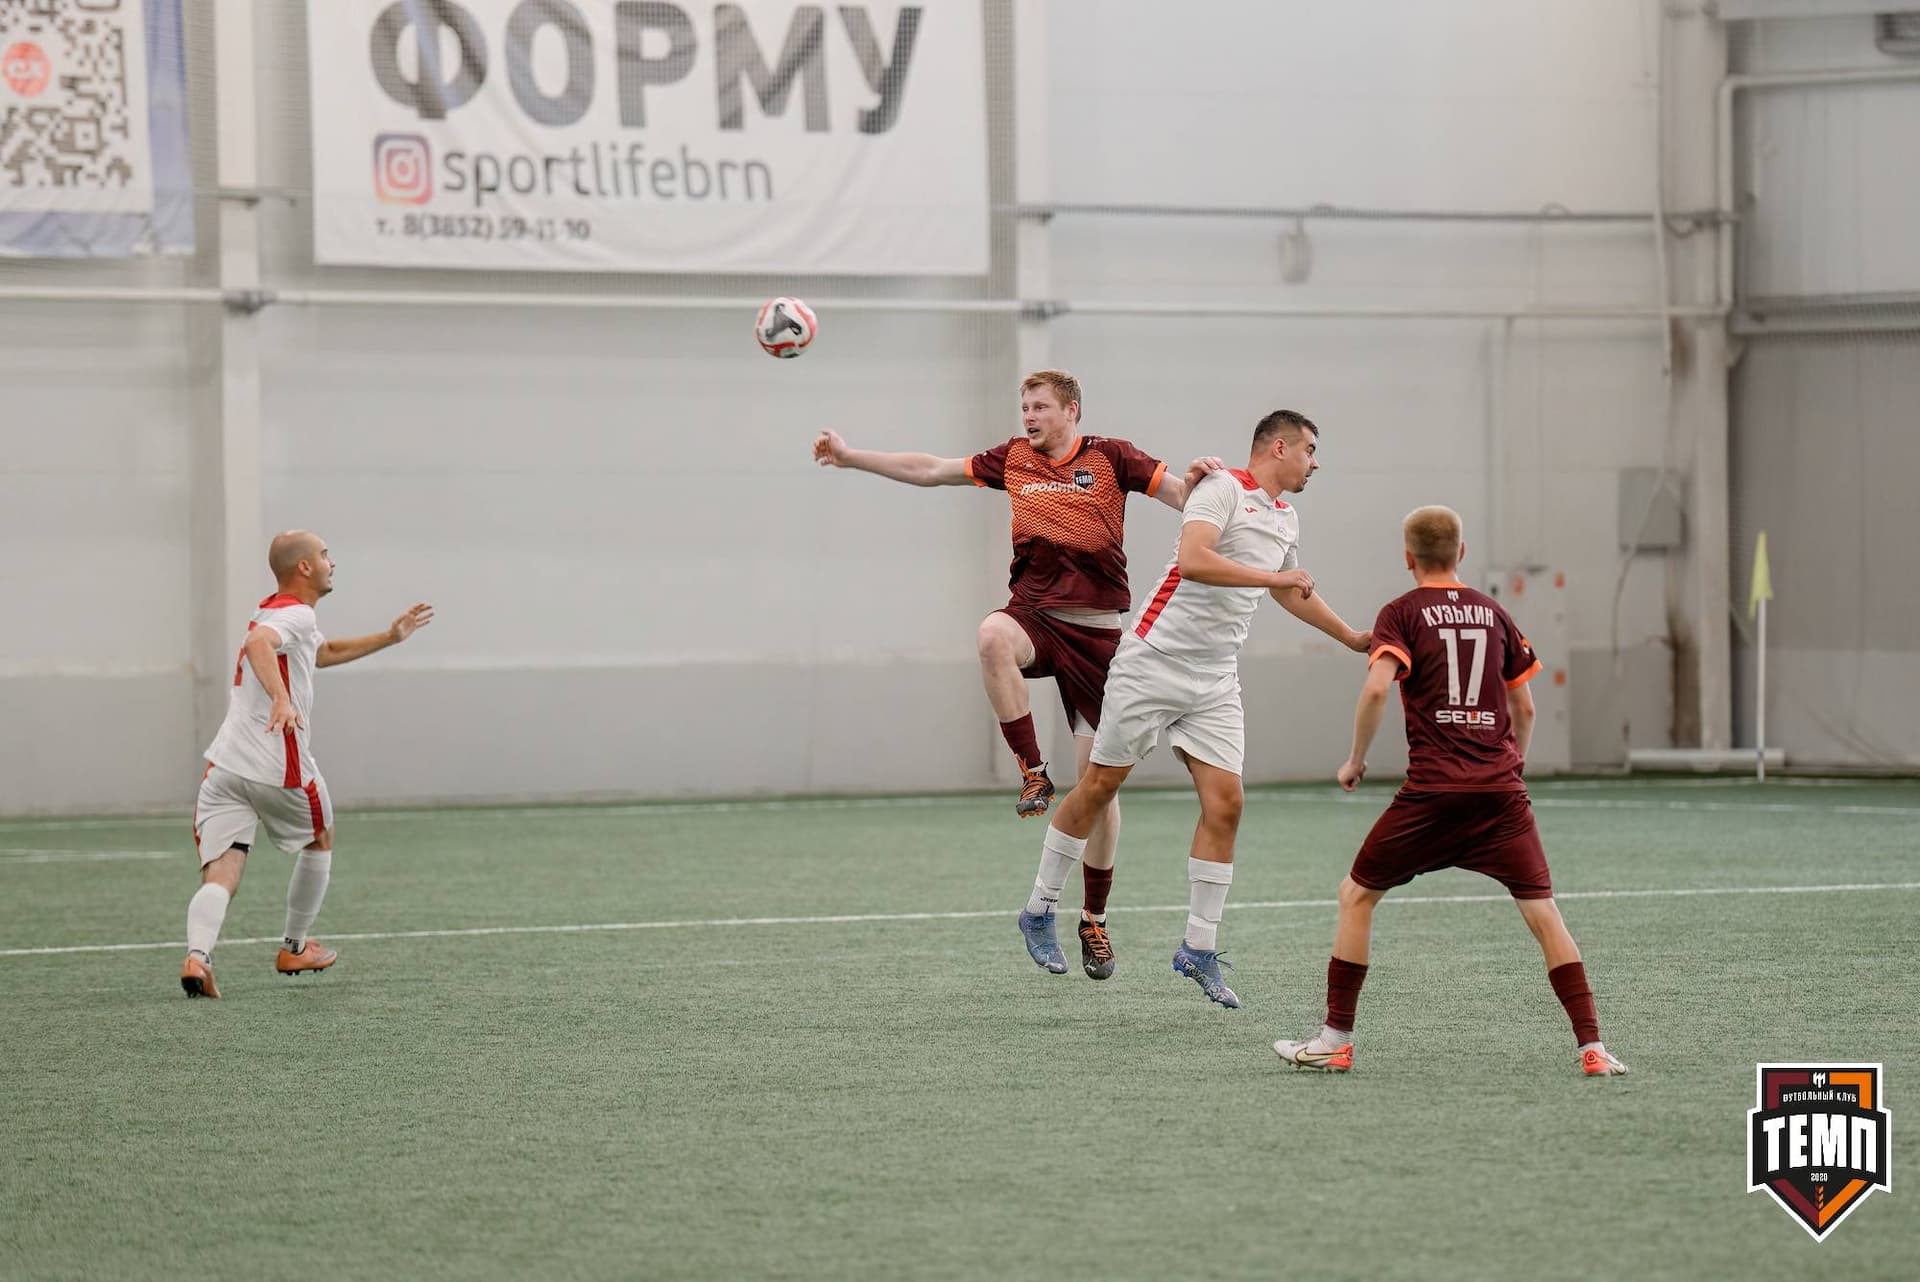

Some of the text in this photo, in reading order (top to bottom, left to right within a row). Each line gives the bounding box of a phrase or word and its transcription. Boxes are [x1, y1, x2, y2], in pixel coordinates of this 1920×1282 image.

[370, 0, 923, 134] ФОРМУ
[442, 140, 773, 207] sportlifebrn
[1421, 605, 1495, 627] КУЗЬКИН
[1438, 628, 1488, 707] 17
[1435, 710, 1496, 726] SEUS
